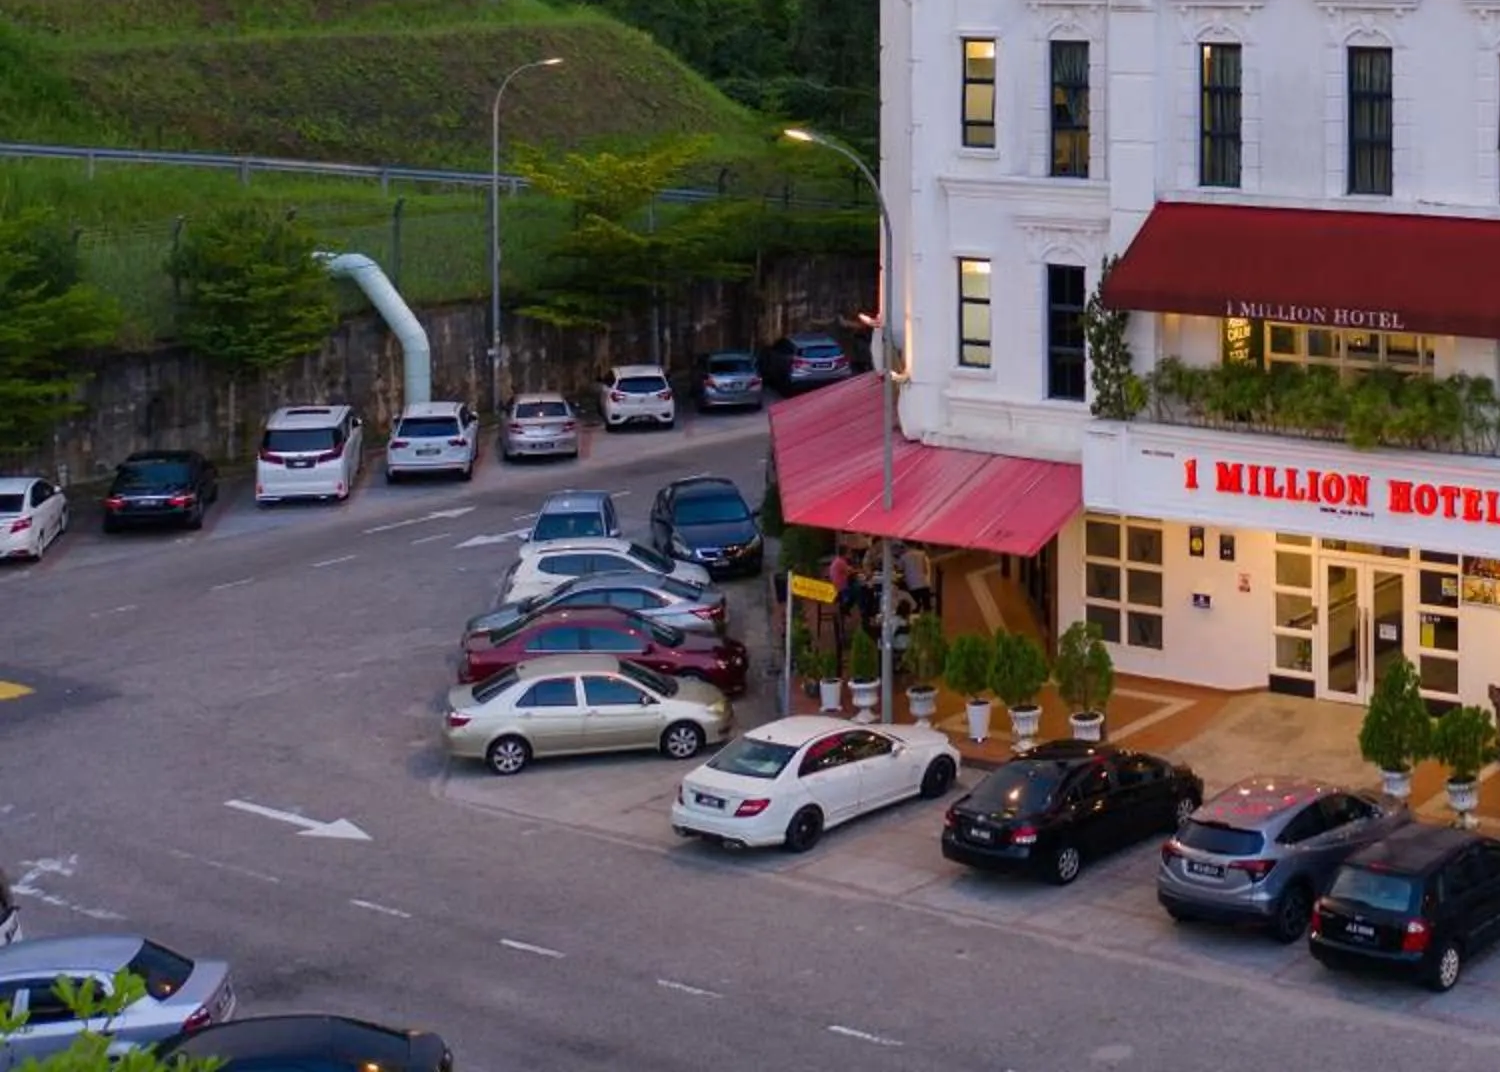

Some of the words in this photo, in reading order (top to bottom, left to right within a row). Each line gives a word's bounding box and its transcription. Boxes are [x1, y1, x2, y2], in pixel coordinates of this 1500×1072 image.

[1226, 300, 1234, 316] 1
[1239, 302, 1327, 324] MILLION
[1333, 306, 1405, 330] HOTEL
[1184, 458, 1199, 490] 1
[1216, 461, 1371, 508] MILLION
